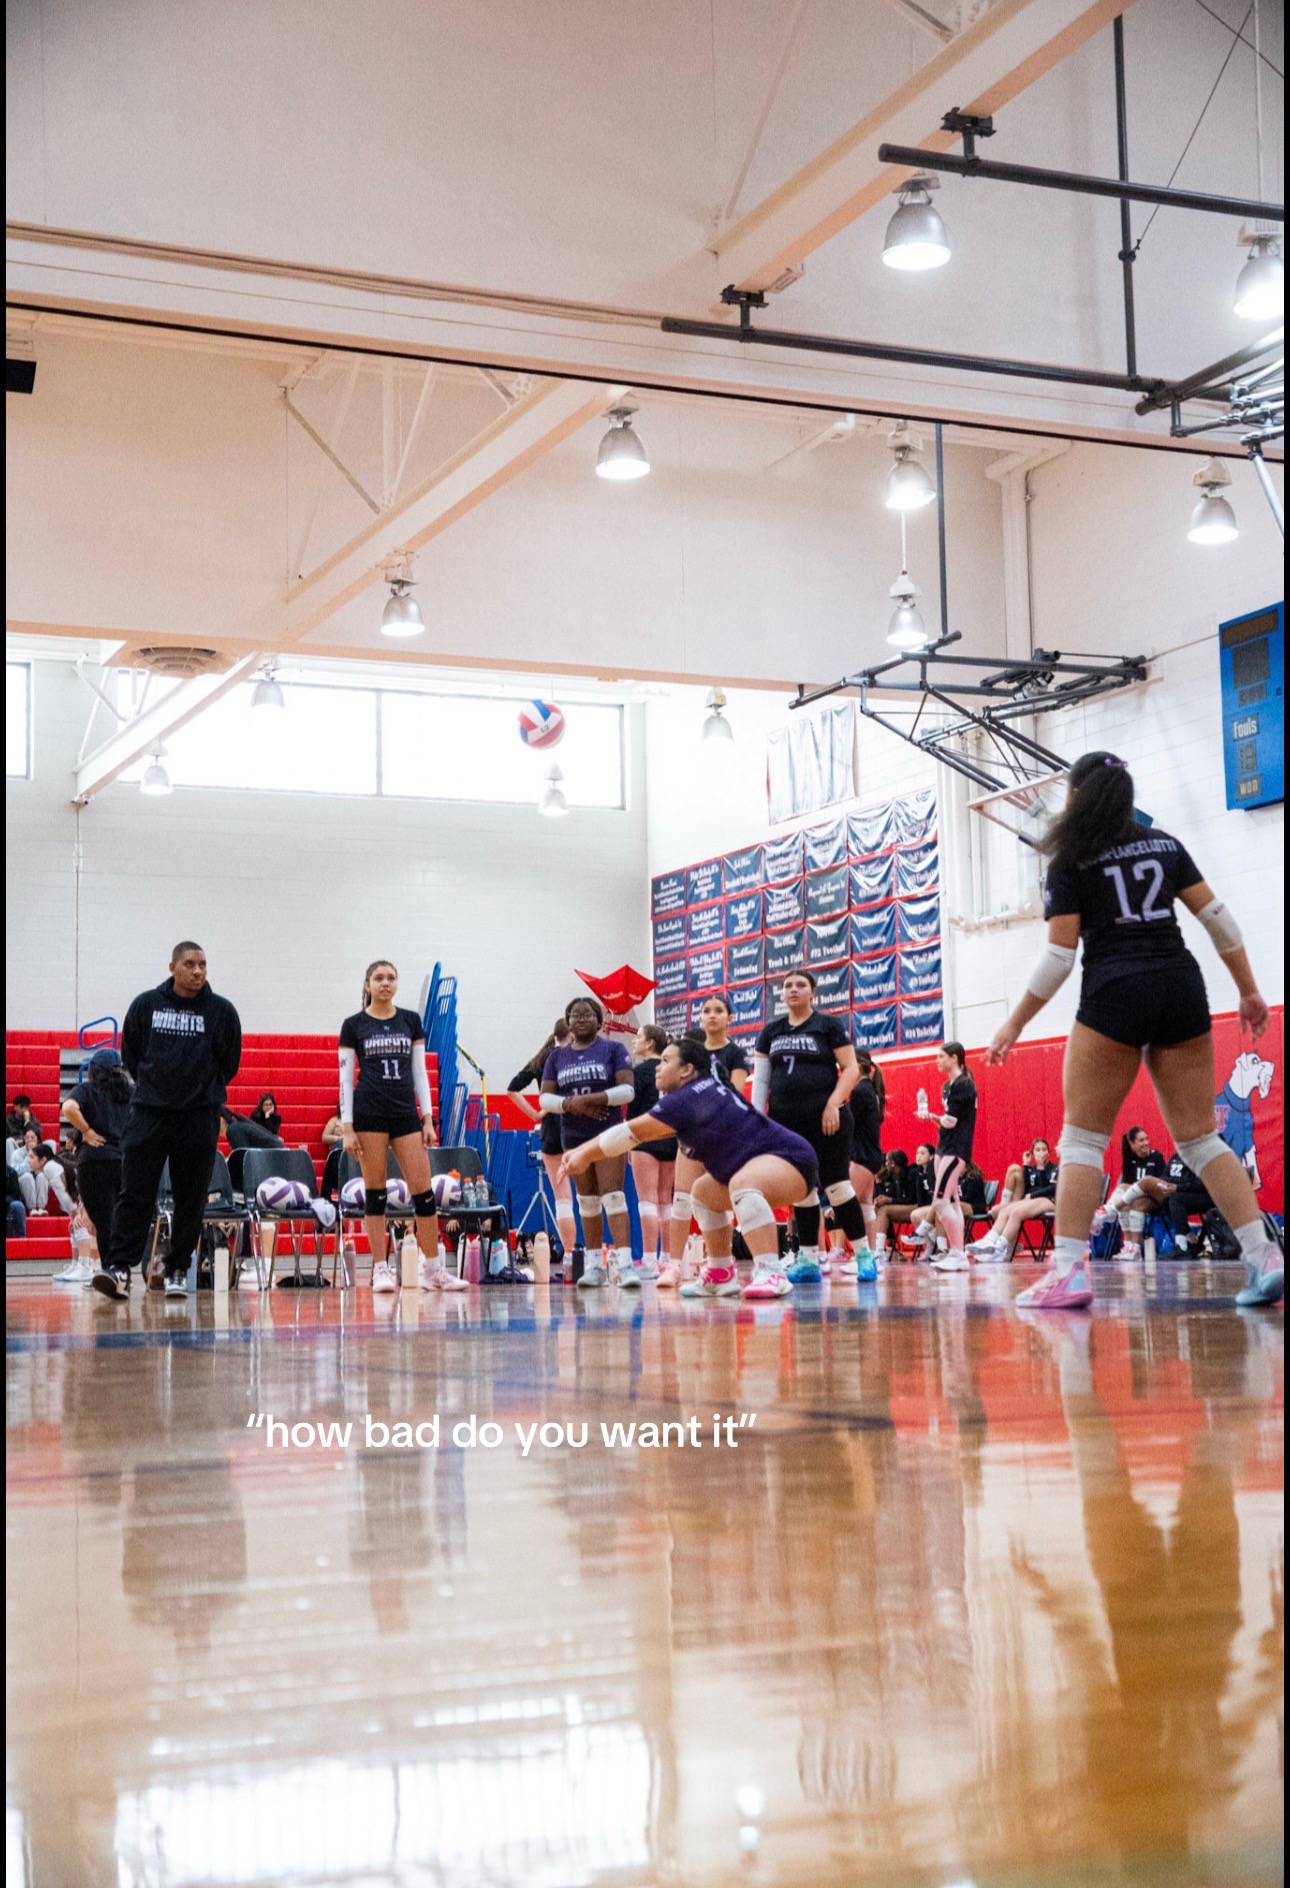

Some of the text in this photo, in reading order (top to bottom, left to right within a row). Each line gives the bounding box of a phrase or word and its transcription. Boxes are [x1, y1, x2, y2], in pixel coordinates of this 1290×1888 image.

[1103, 859, 1172, 924] 12
[822, 941, 846, 956] Football
[768, 956, 783, 969] Track
[790, 952, 804, 964] Field
[733, 964, 758, 978] Swimming
[820, 990, 849, 1005] Basketball
[152, 1010, 205, 1033] KNIGHTS
[365, 1037, 412, 1056] KNIGHTS
[769, 1036, 818, 1056] KNIGHTS
[869, 1032, 894, 1045] Football
[381, 1059, 402, 1080] 11
[782, 1055, 795, 1075] 7
[557, 1063, 607, 1088] KNIGHTS
[1169, 1163, 1183, 1177] 22
